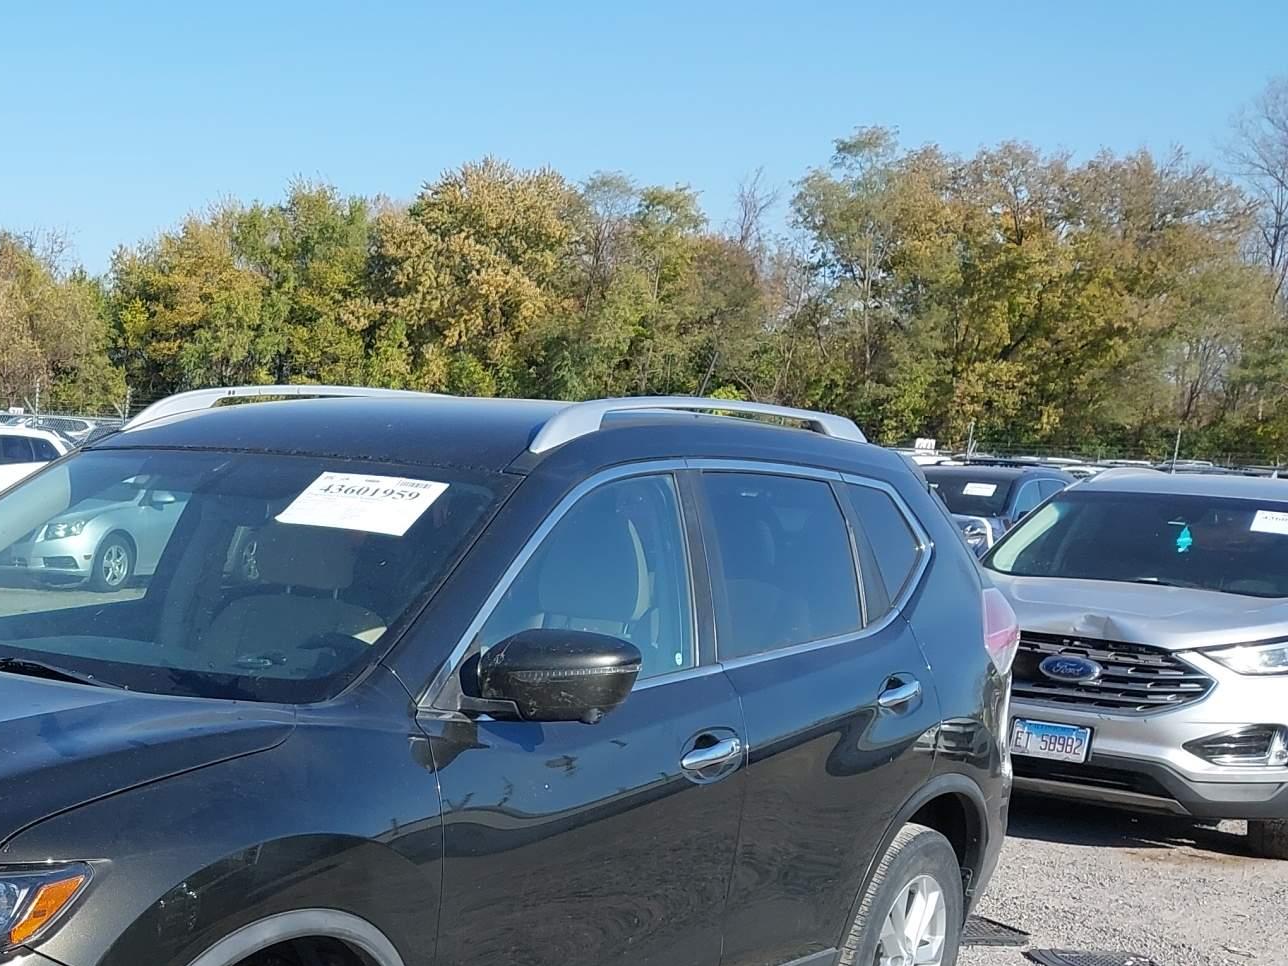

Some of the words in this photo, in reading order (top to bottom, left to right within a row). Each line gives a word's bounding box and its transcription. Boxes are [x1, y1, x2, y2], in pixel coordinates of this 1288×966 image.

[319, 483, 420, 501] 43601959
[1052, 662, 1084, 676] Ford
[1014, 730, 1033, 749] ET
[1040, 734, 1083, 756] 58982
